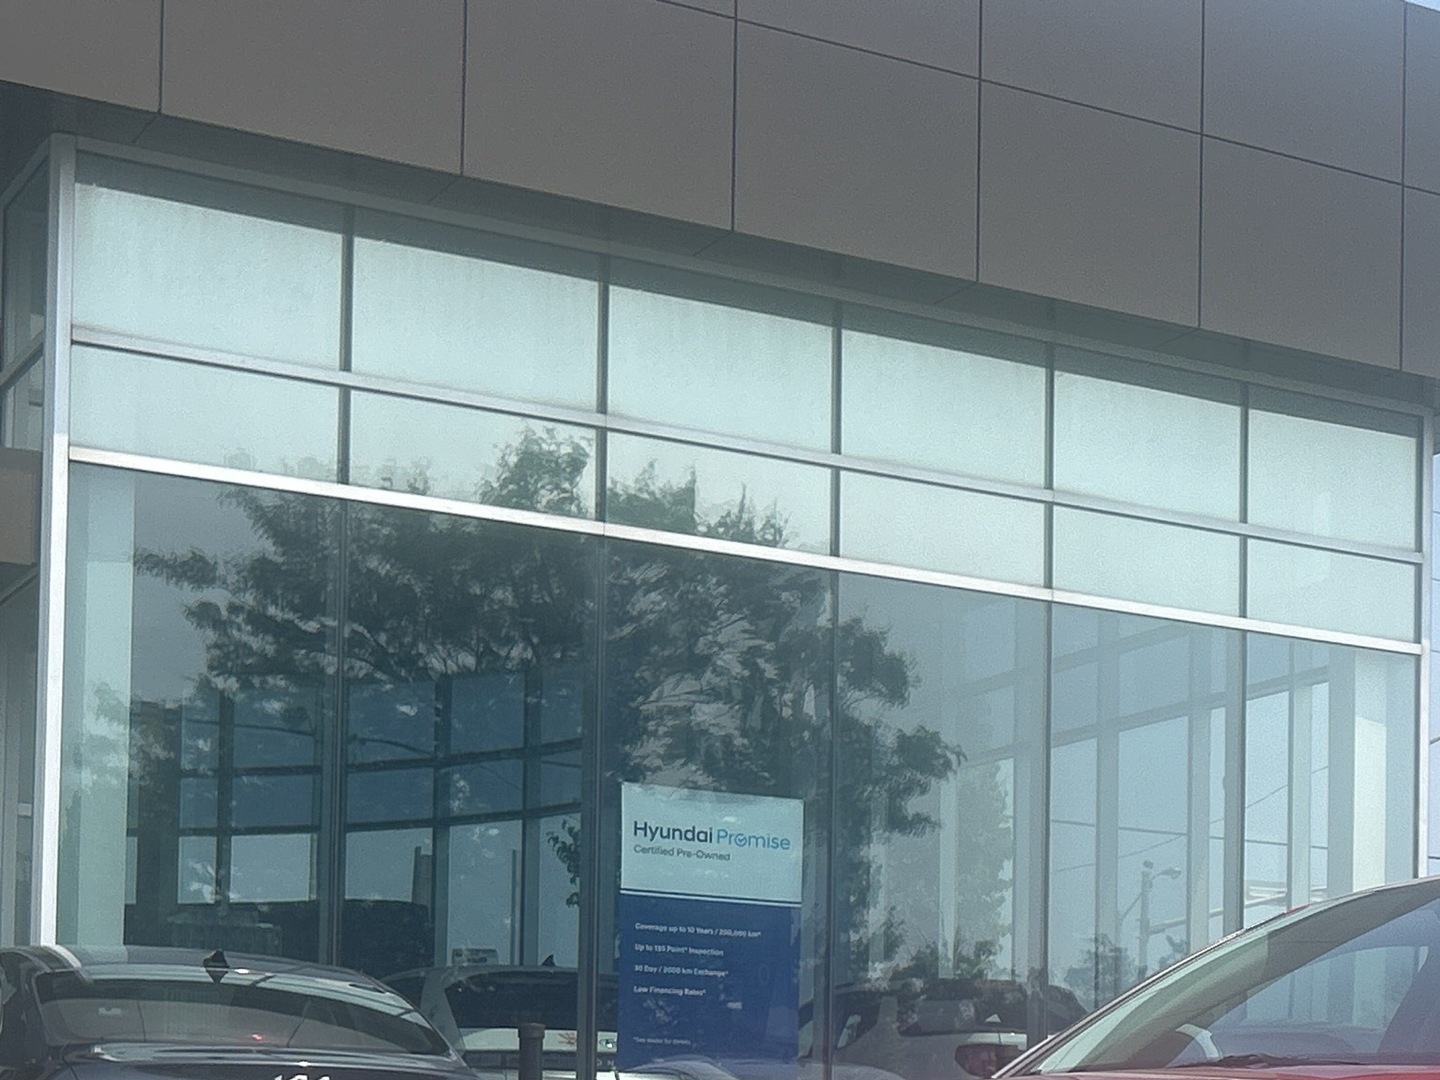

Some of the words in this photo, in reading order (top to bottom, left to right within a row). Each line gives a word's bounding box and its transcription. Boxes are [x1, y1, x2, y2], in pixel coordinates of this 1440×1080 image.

[633, 820, 713, 843] Hyundai
[716, 829, 791, 850] Promise
[633, 845, 675, 857] Certified
[676, 847, 731, 861] Pre-Owned
[635, 922, 667, 933] Coverage
[688, 946, 724, 956] Inspection
[649, 986, 683, 996] Financing
